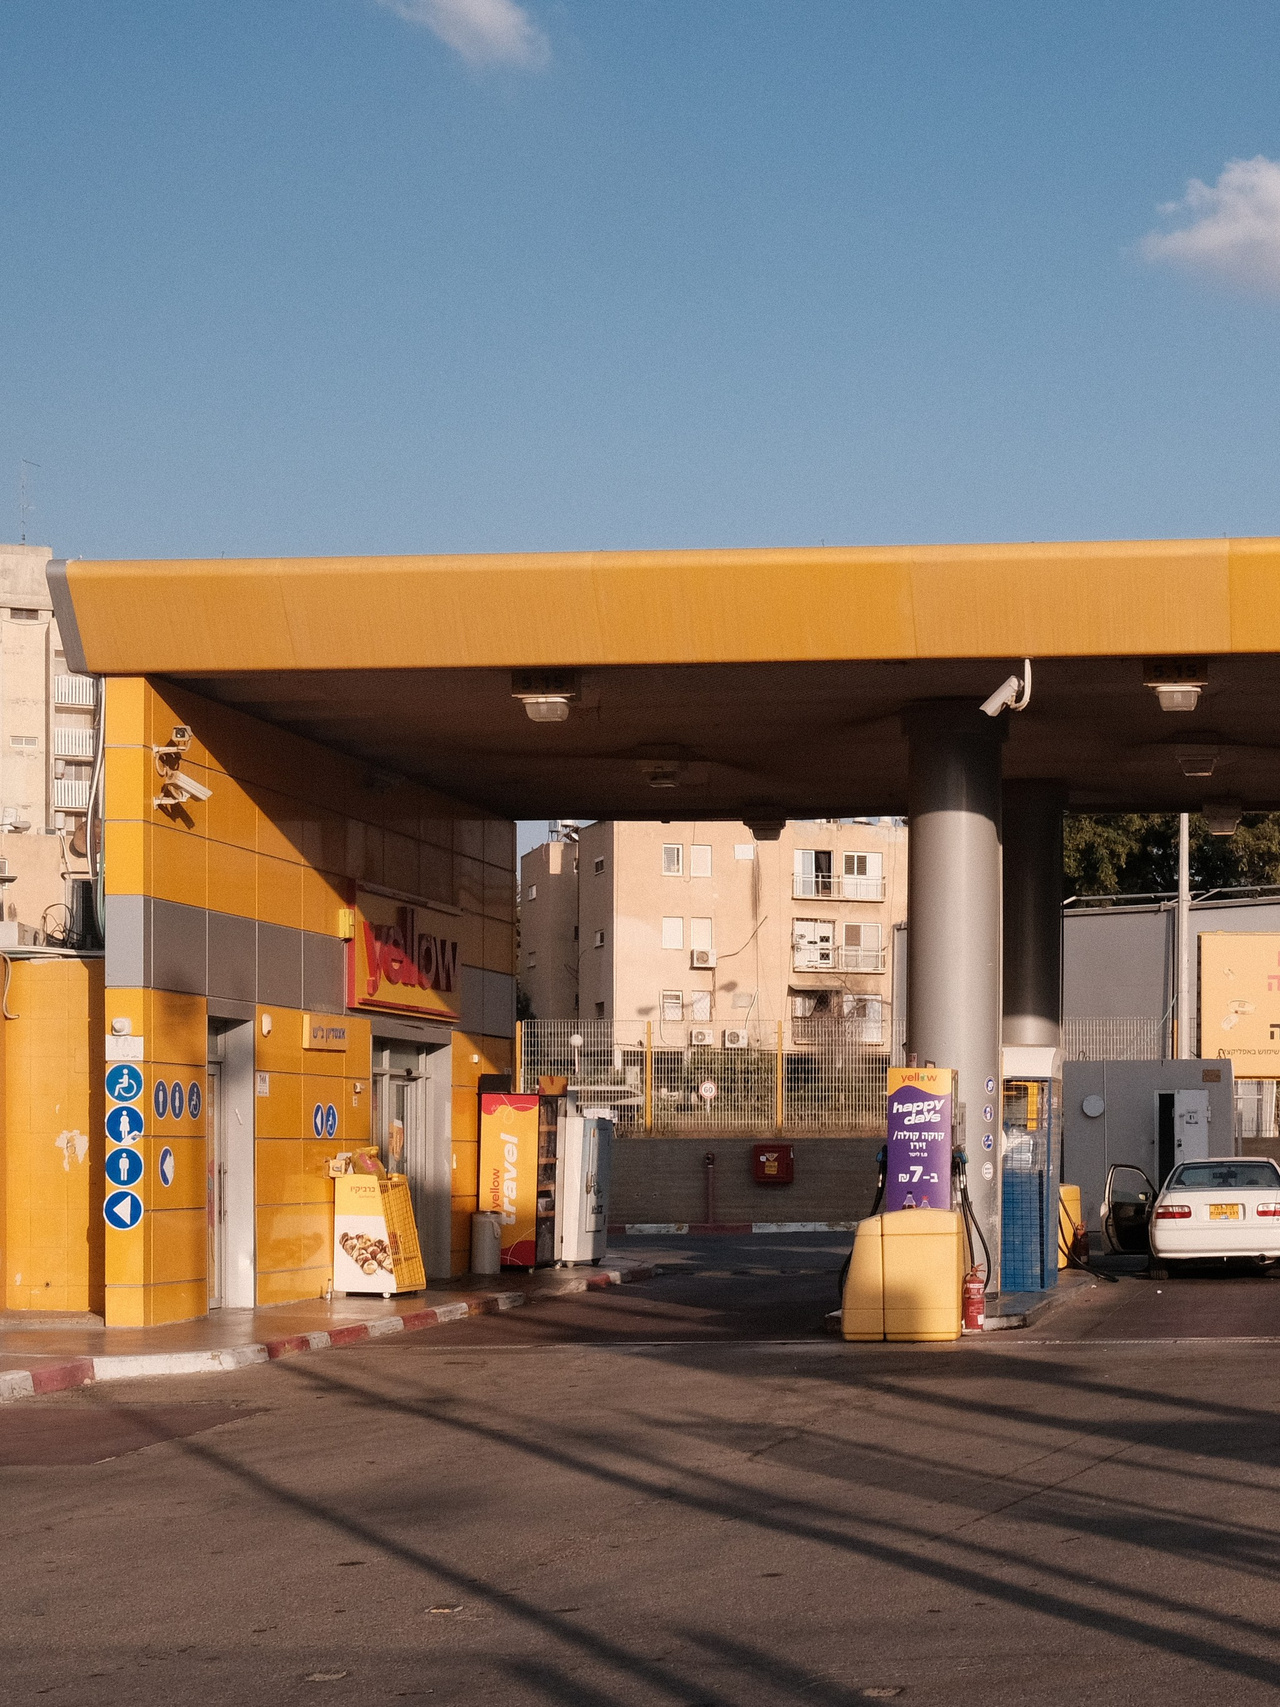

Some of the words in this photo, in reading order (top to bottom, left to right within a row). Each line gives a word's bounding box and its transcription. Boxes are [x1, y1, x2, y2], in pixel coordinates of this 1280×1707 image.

[363, 906, 458, 997] yellow
[893, 1099, 945, 1114] happy
[903, 1110, 941, 1125] days
[893, 1130, 920, 1141] קולה/
[921, 1131, 945, 1141] קוקה
[910, 1142, 926, 1150] זירו
[500, 1132, 519, 1226] travel
[489, 1167, 501, 1211] yellow
